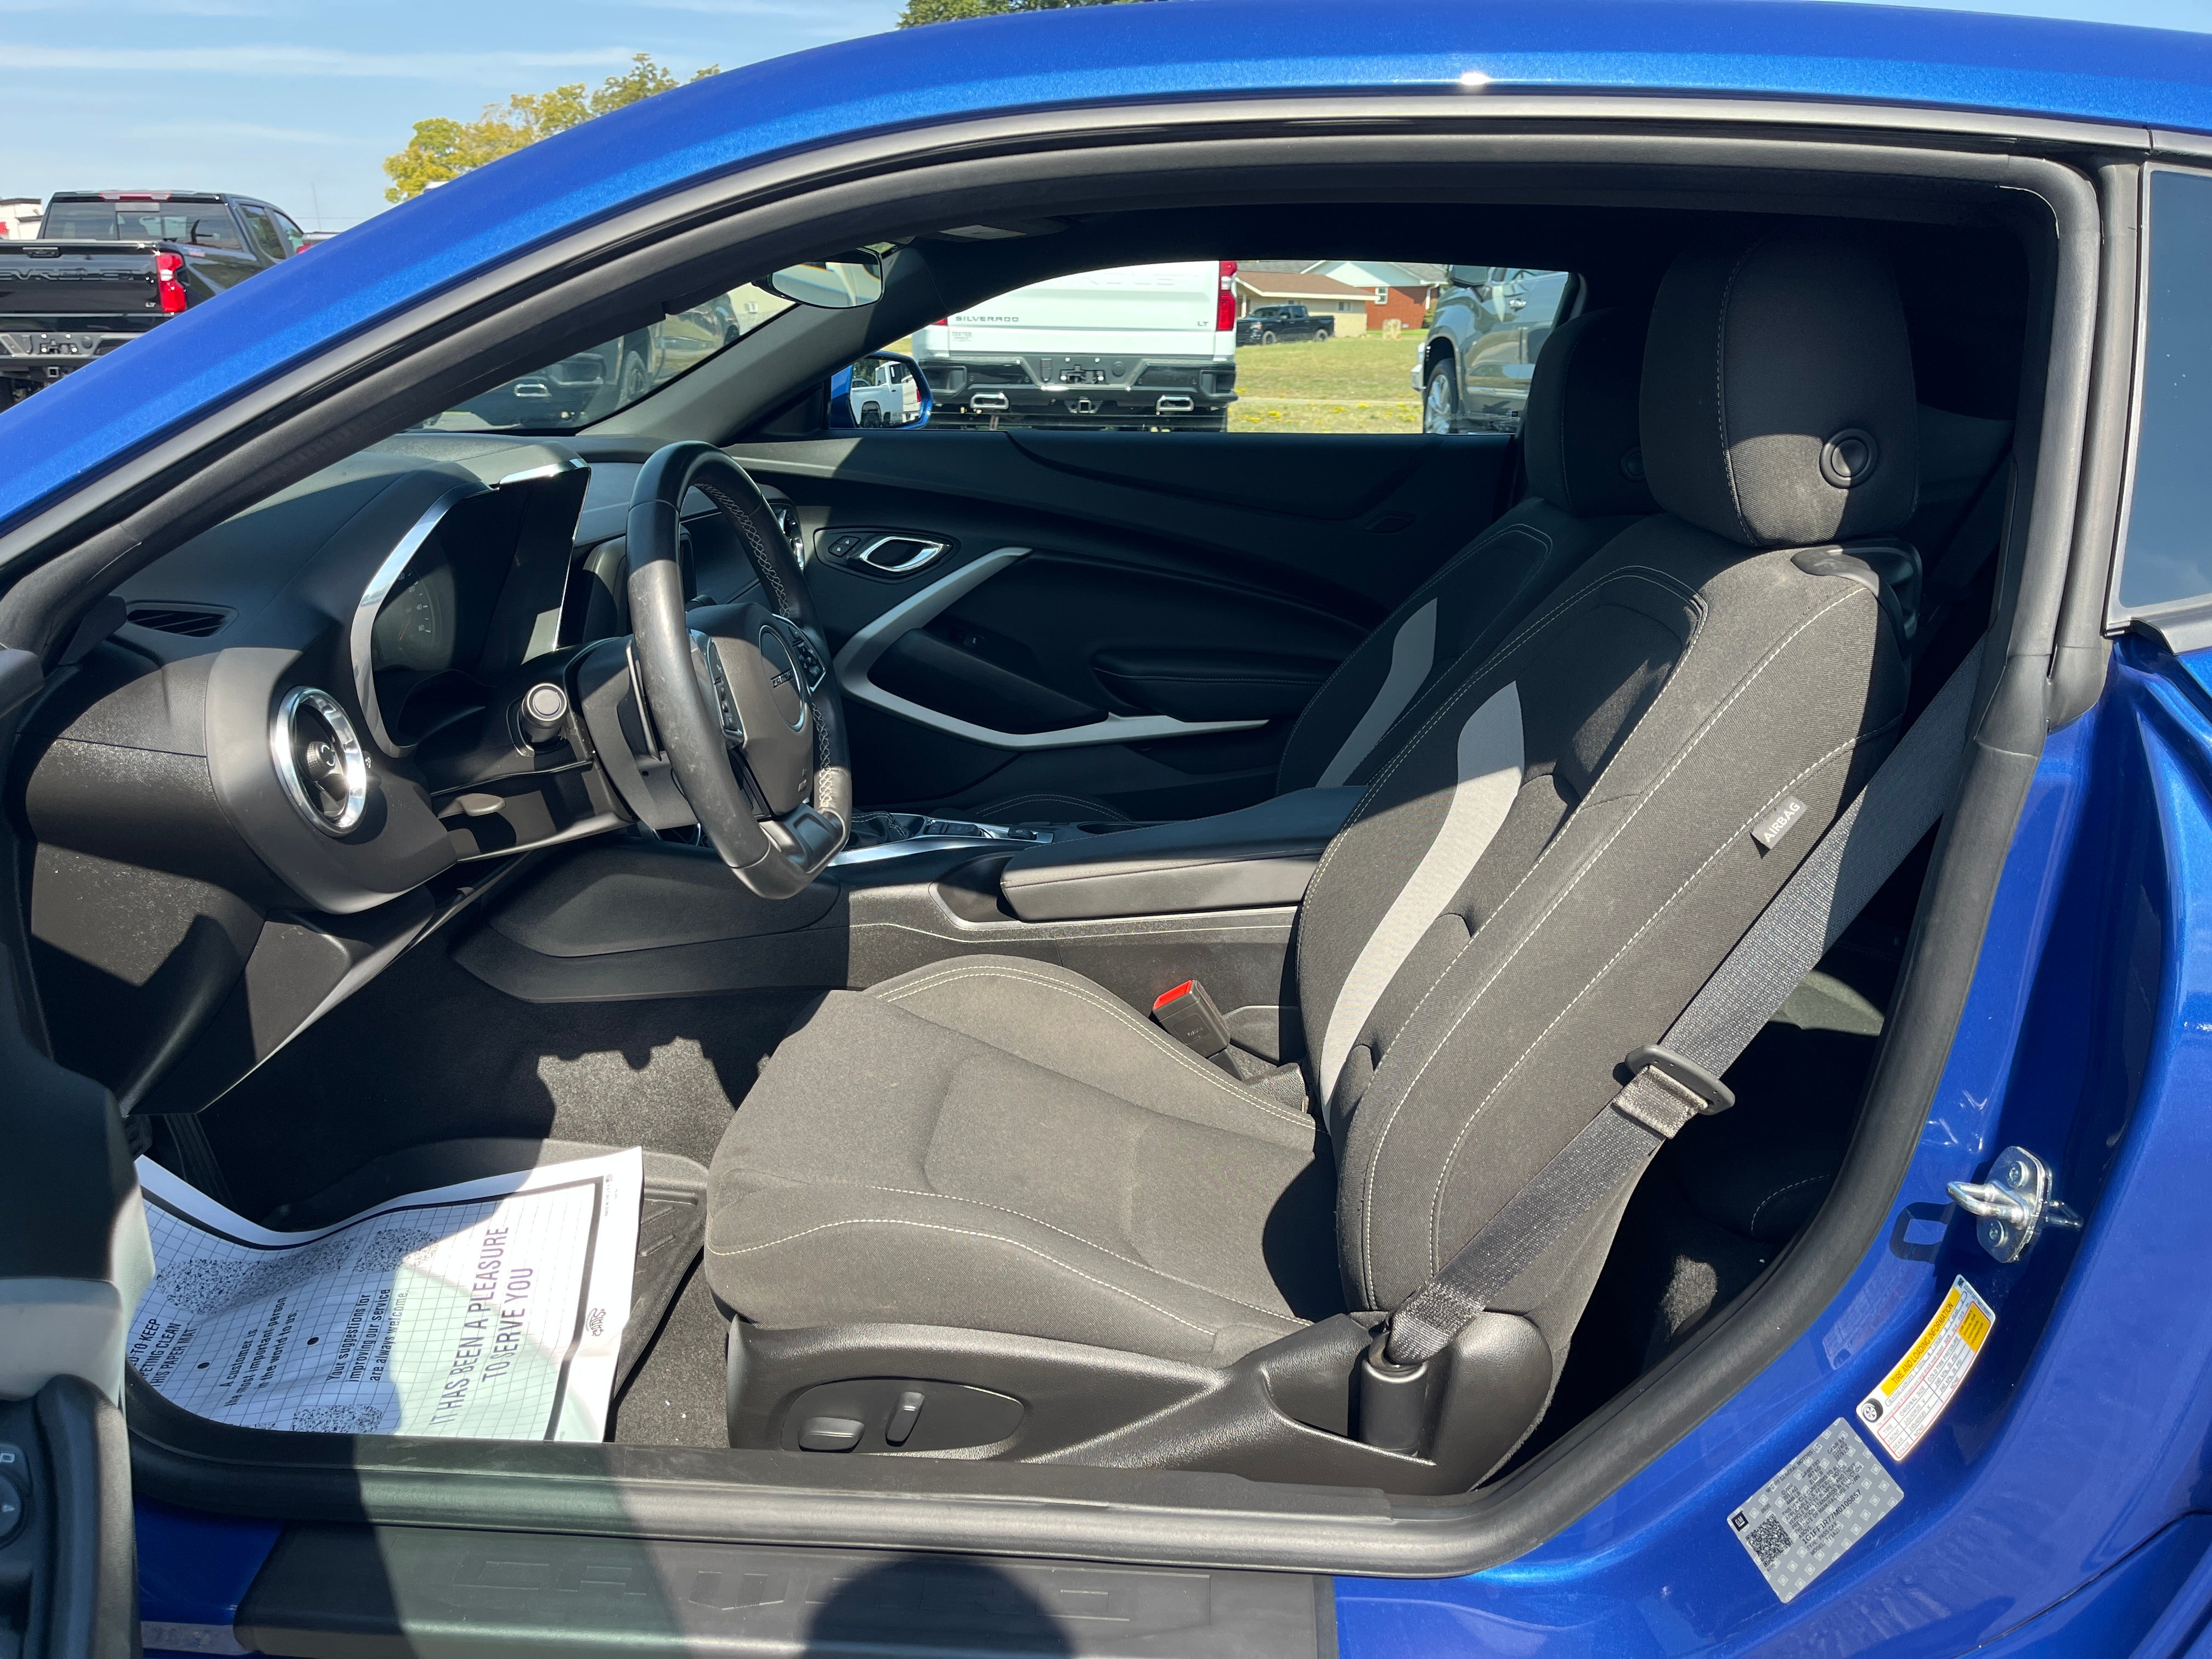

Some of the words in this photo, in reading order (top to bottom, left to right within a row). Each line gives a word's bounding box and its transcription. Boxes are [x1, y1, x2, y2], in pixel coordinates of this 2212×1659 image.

[1763, 802, 1801, 843] AIRBAG
[468, 1227, 509, 1312] PLEASURE
[504, 1268, 533, 1304] YOU
[267, 1297, 287, 1327] person
[285, 1310, 298, 1323] us.
[371, 1289, 391, 1321] service
[387, 1290, 409, 1333] welcome.
[130, 1344, 148, 1353] TO
[139, 1319, 160, 1341] KEEP
[278, 1326, 292, 1335] to
[326, 1363, 346, 1381] Your
[338, 1308, 365, 1359] suggestions
[356, 1295, 370, 1306] for
[365, 1324, 379, 1338] our
[464, 1318, 488, 1329] A
[490, 1308, 526, 1359] SERVE
[139, 1351, 164, 1378] PETING
[155, 1323, 181, 1348] CLEAN
[150, 1372, 170, 1387] THIS
[160, 1346, 187, 1369] PAPER
[176, 1328, 197, 1344] MAT
[226, 1341, 253, 1379] customer
[244, 1329, 258, 1338] is
[245, 1329, 274, 1372] important
[269, 1338, 288, 1363] world
[375, 1337, 396, 1363] always
[449, 1337, 484, 1375] BEEN
[1892, 1369, 1904, 1384] TIRE
[1901, 1359, 1912, 1373] AND
[1910, 1336, 1930, 1362] LOADING
[1928, 1301, 1953, 1339] INFORMATION
[261, 1365, 276, 1380] the
[346, 1341, 376, 1382] improving
[370, 1367, 383, 1380] are
[481, 1362, 511, 1383] TO
[1916, 1358, 1925, 1369] TOTAL
[236, 1374, 256, 1393] most
[437, 1379, 470, 1410] HAS
[1883, 1423, 1893, 1434] TIRE
[1899, 1396, 1917, 1417] ORIGINAL
[1916, 1385, 1925, 1396] SIZE
[1927, 1369, 1937, 1382] COLD
[1936, 1359, 1944, 1370] TIRE
[1943, 1335, 1959, 1360] PRESSURE
[224, 1395, 242, 1407] the
[1897, 1441, 1910, 1455] SPARE
[1914, 1424, 1925, 1437] NONE
[1949, 1375, 1959, 1389] NONE
[429, 1413, 458, 1425] IT
[1887, 1428, 1900, 1443] FRONT
[1892, 1436, 1903, 1449] REAR
[1779, 1464, 1797, 1481] GENERAL
[1796, 1449, 1813, 1466] MOTORS
[1801, 1465, 1813, 1478] GAWR
[1781, 1506, 1791, 1516] THIS
[1791, 1493, 1807, 1509] VEHICLE
[1806, 1475, 1828, 1495] CONFORMS
[1785, 1499, 1808, 1520] APPLICABLE
[1815, 1477, 1832, 1493] FEDERAL
[1832, 1464, 1846, 1479] MOTOR
[1788, 1509, 1804, 1525] VEHICLE
[1835, 1473, 1844, 1482] AND
[1843, 1463, 1856, 1476] THEFT
[1791, 1507, 1815, 1529] PREVENTION
[1814, 1487, 1837, 1509] STANDARDS
[1841, 1470, 1855, 1485] EFFECT
[1795, 1525, 1803, 1534] THE
[1802, 1516, 1813, 1527] DATE
[1818, 1487, 1846, 1513] MANUFACTURE
[1845, 1474, 1860, 1488] SHOWN
[1735, 1515, 1743, 1525] GM
[1801, 1488, 1862, 1544] 1G1FF1R77M0105857
[1818, 1528, 1829, 1540] PASS
[1828, 1521, 1837, 1531] CAR
